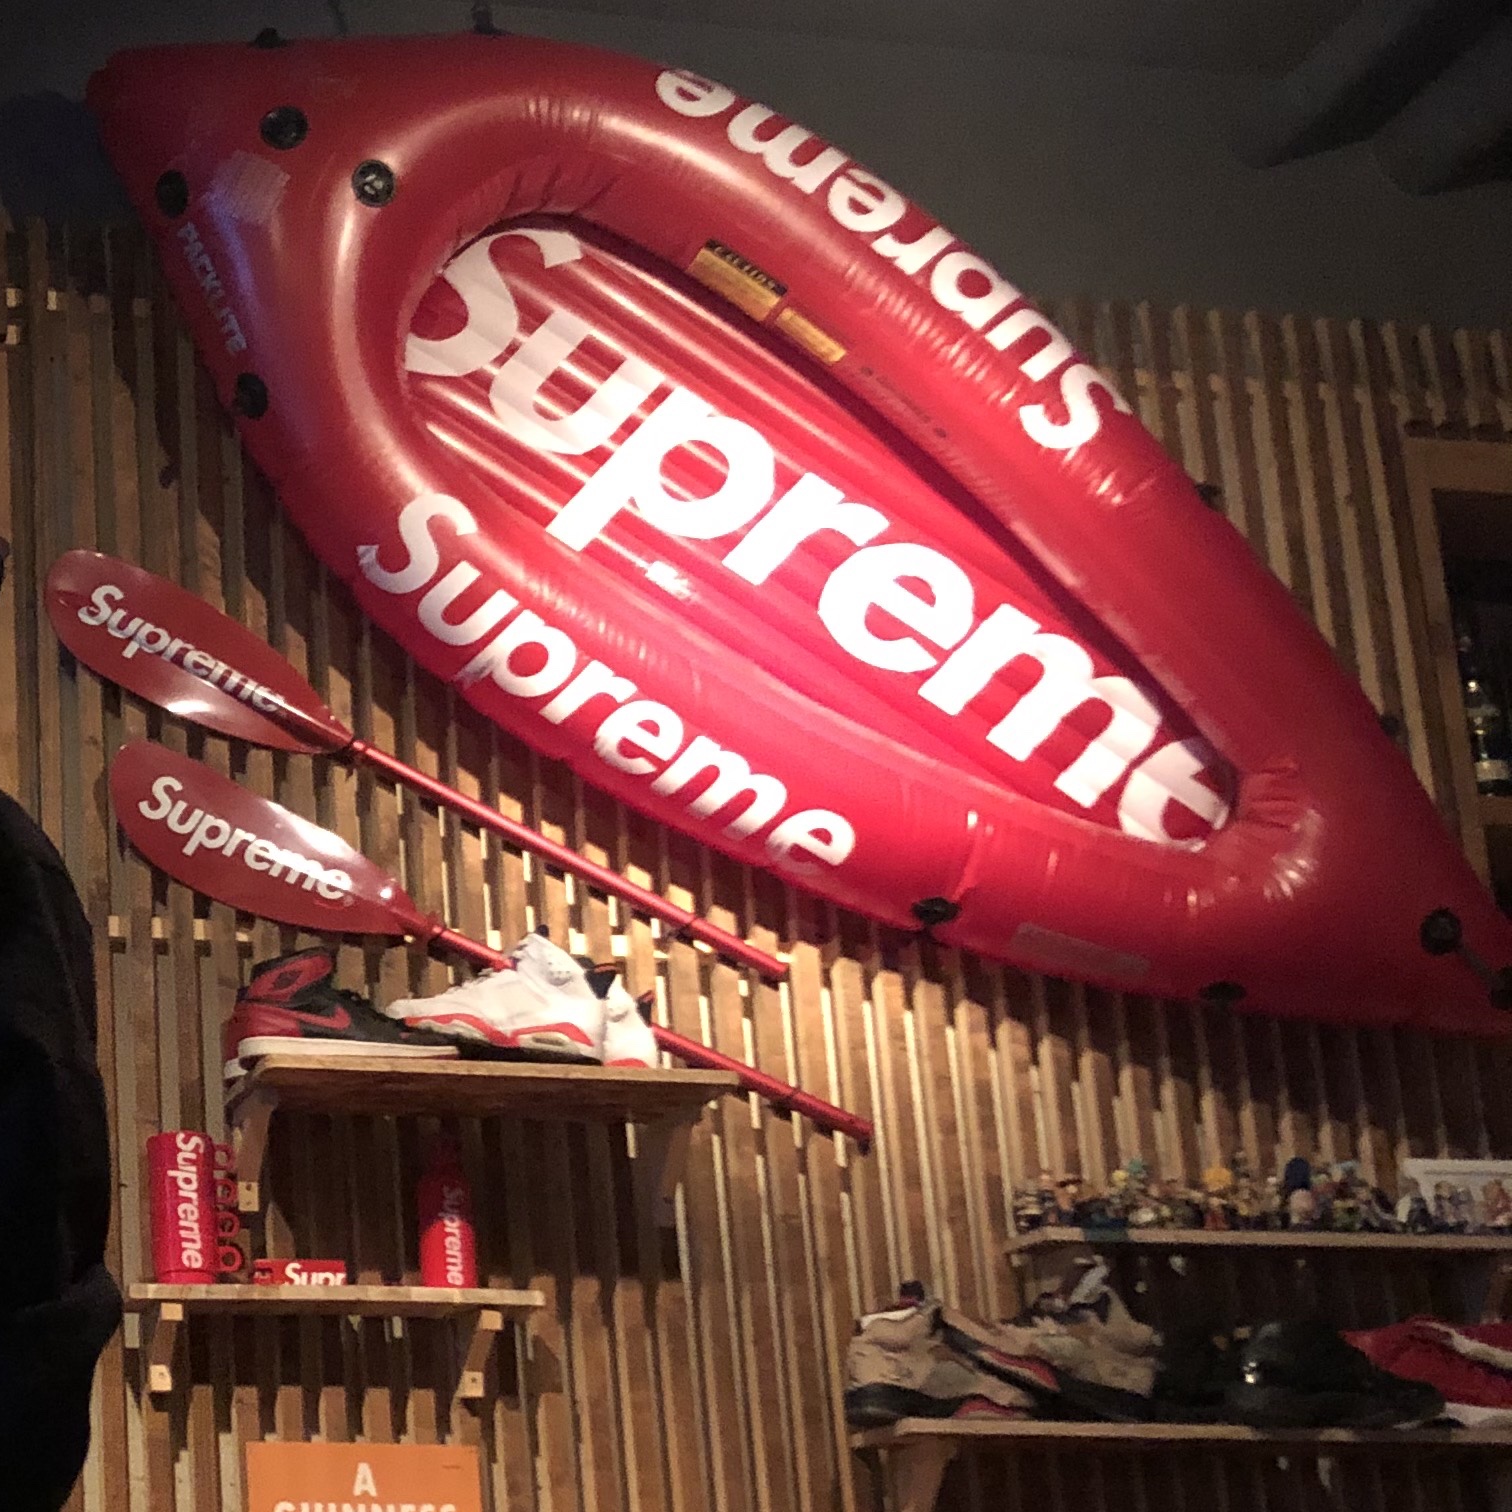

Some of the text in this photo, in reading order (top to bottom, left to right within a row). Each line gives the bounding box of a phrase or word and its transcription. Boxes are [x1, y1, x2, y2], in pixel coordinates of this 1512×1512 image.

[654, 68, 1134, 450] Supreme
[404, 228, 1236, 853] Supreme
[77, 585, 288, 713] Supreme
[357, 492, 856, 876] Supreme
[138, 775, 355, 901] Supreme
[167, 1131, 205, 1270] Supreme
[436, 1183, 465, 1287] Supreme
[352, 1462, 378, 1497] A
